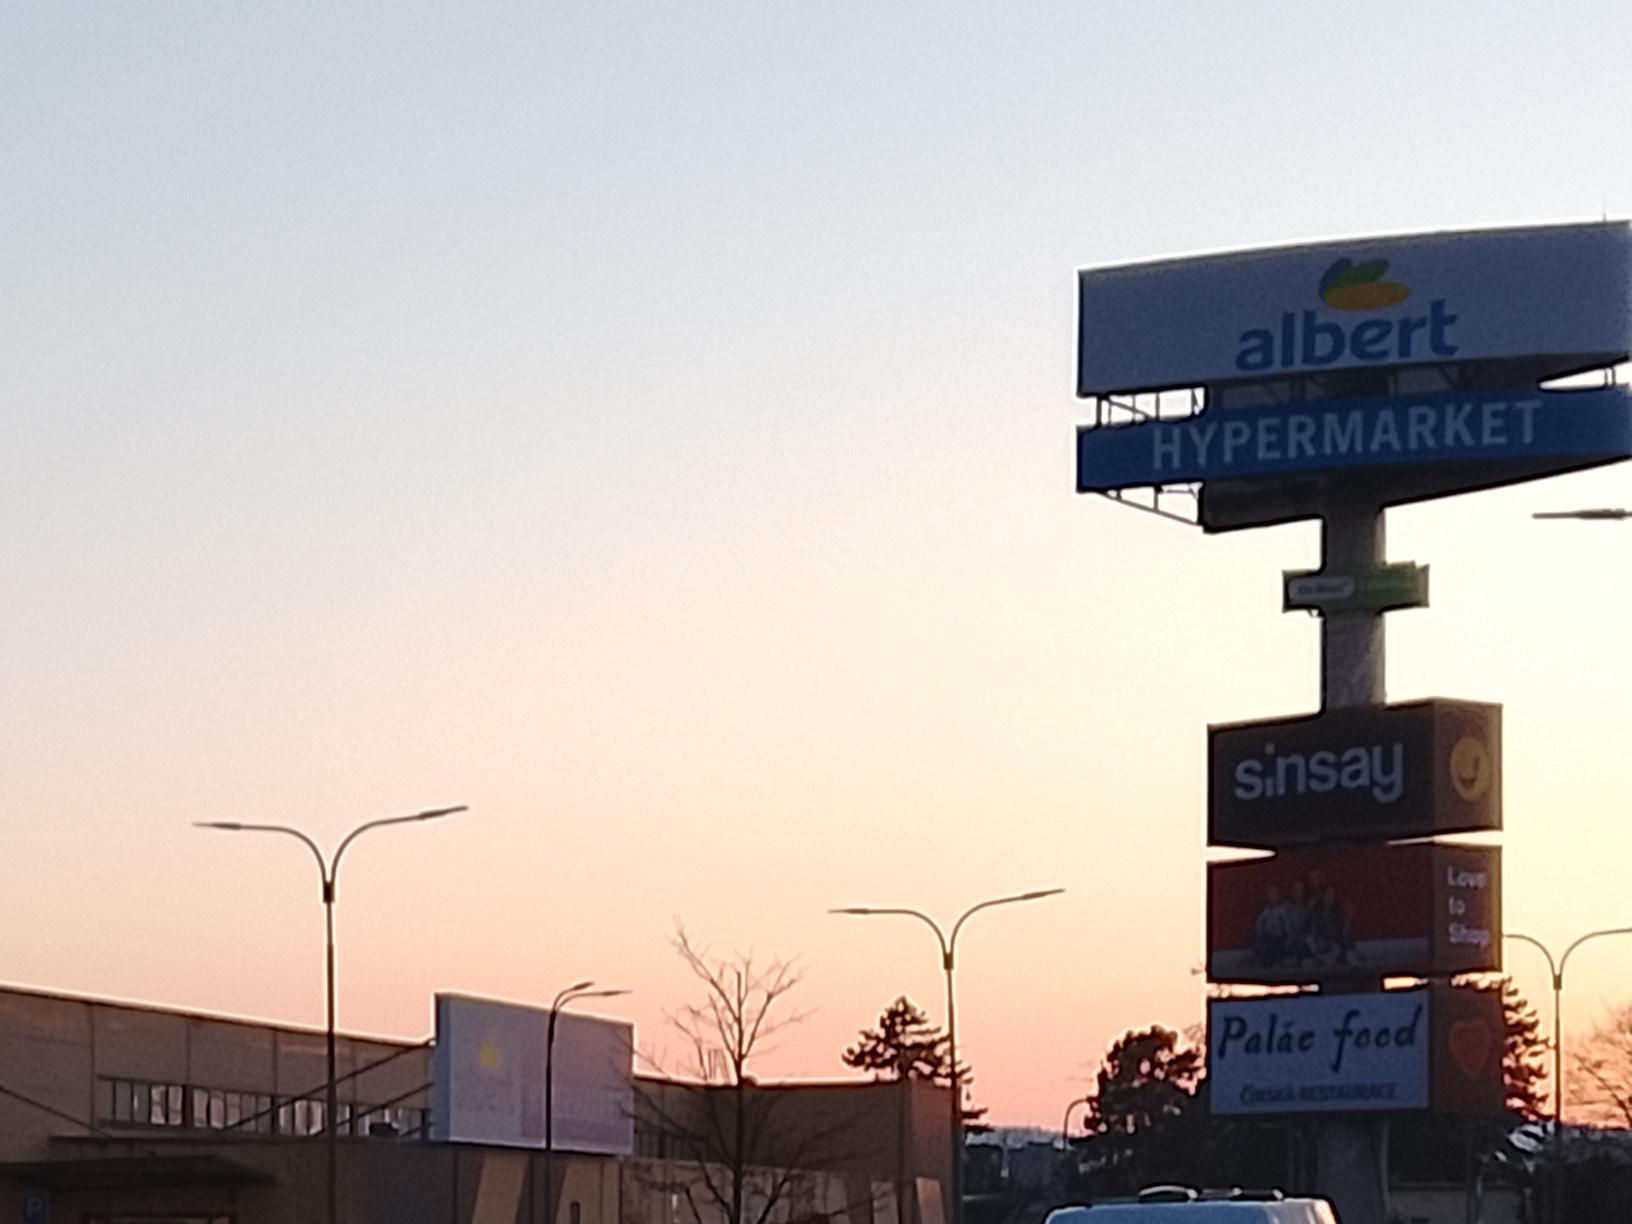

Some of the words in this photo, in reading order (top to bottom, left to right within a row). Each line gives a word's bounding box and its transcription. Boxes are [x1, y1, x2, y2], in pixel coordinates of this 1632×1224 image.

[1235, 298, 1460, 373] albert
[1152, 400, 1543, 471] HYPERMARKET
[1234, 741, 1405, 804] sinsay
[1447, 865, 1487, 889] Love
[1448, 895, 1467, 915] to
[1448, 921, 1491, 949] Shop
[1218, 1012, 1315, 1059] Palác
[1331, 1003, 1423, 1073] food
